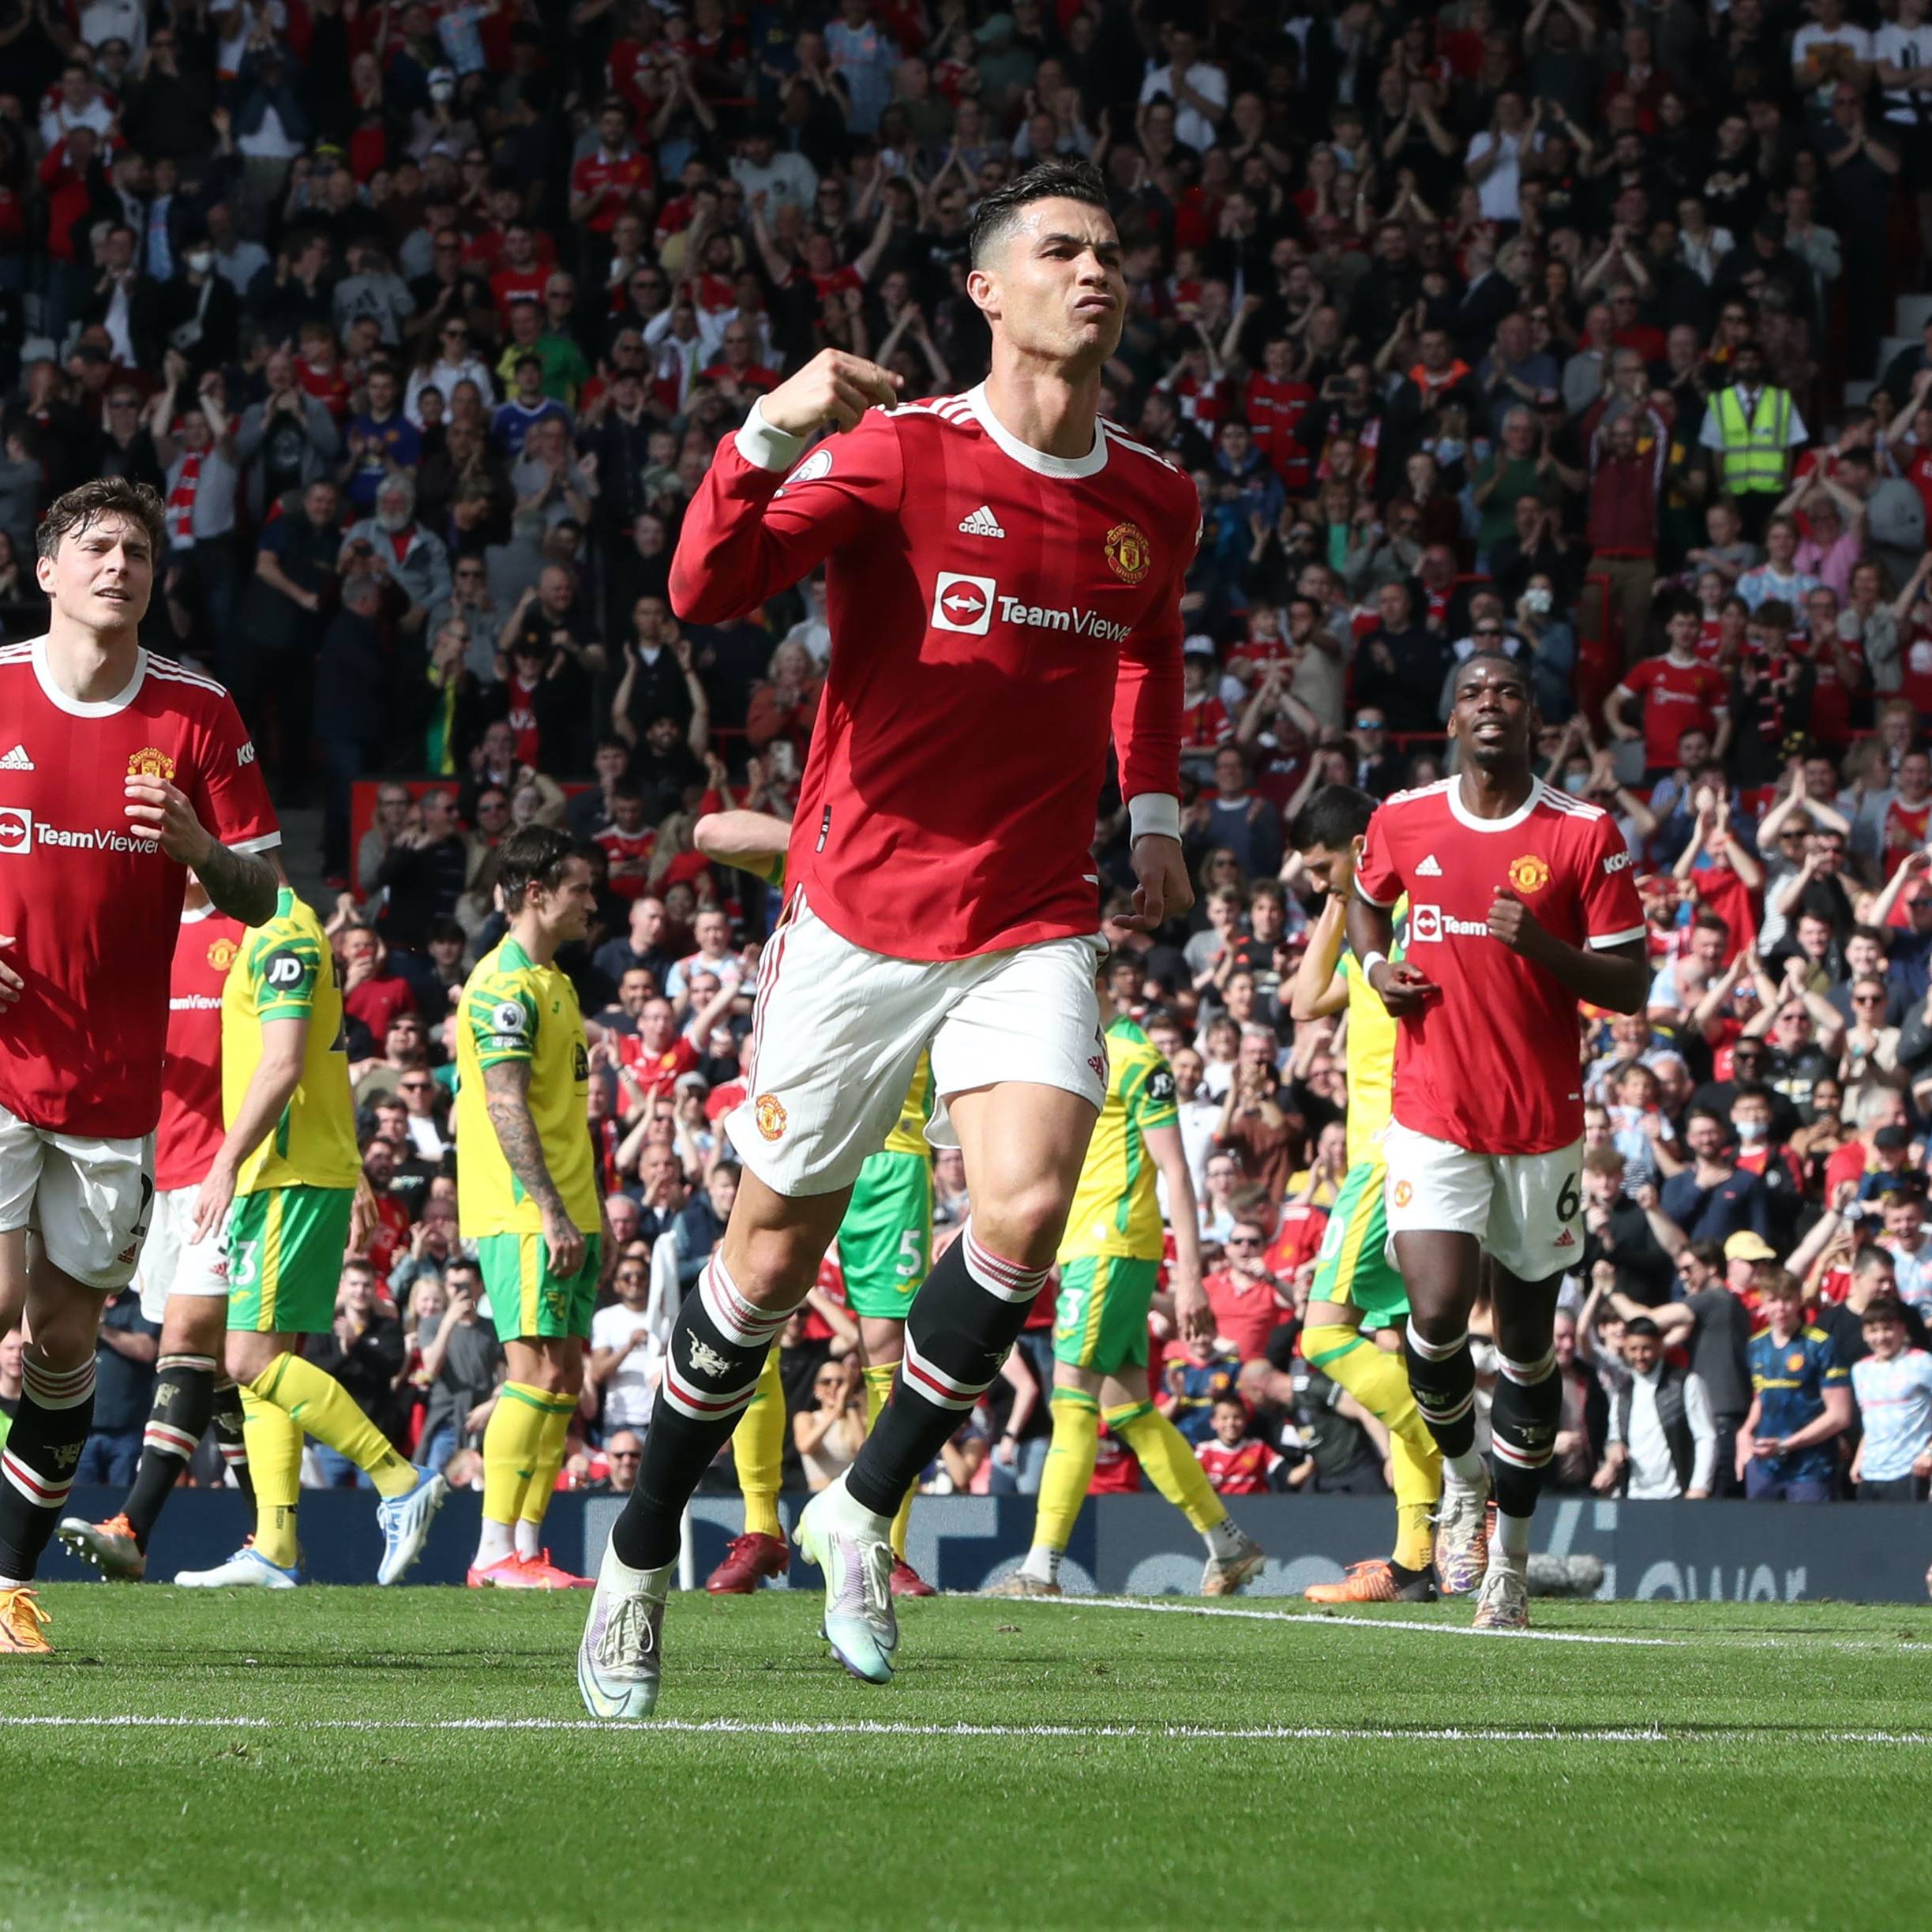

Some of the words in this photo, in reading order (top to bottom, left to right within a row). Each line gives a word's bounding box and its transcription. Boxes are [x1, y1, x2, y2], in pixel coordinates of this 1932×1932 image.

[958, 519, 1006, 538] adidas
[268, 958, 302, 984] JD
[1555, 1171, 1580, 1223] 6
[227, 1240, 257, 1285] 3
[895, 1229, 922, 1277] 5
